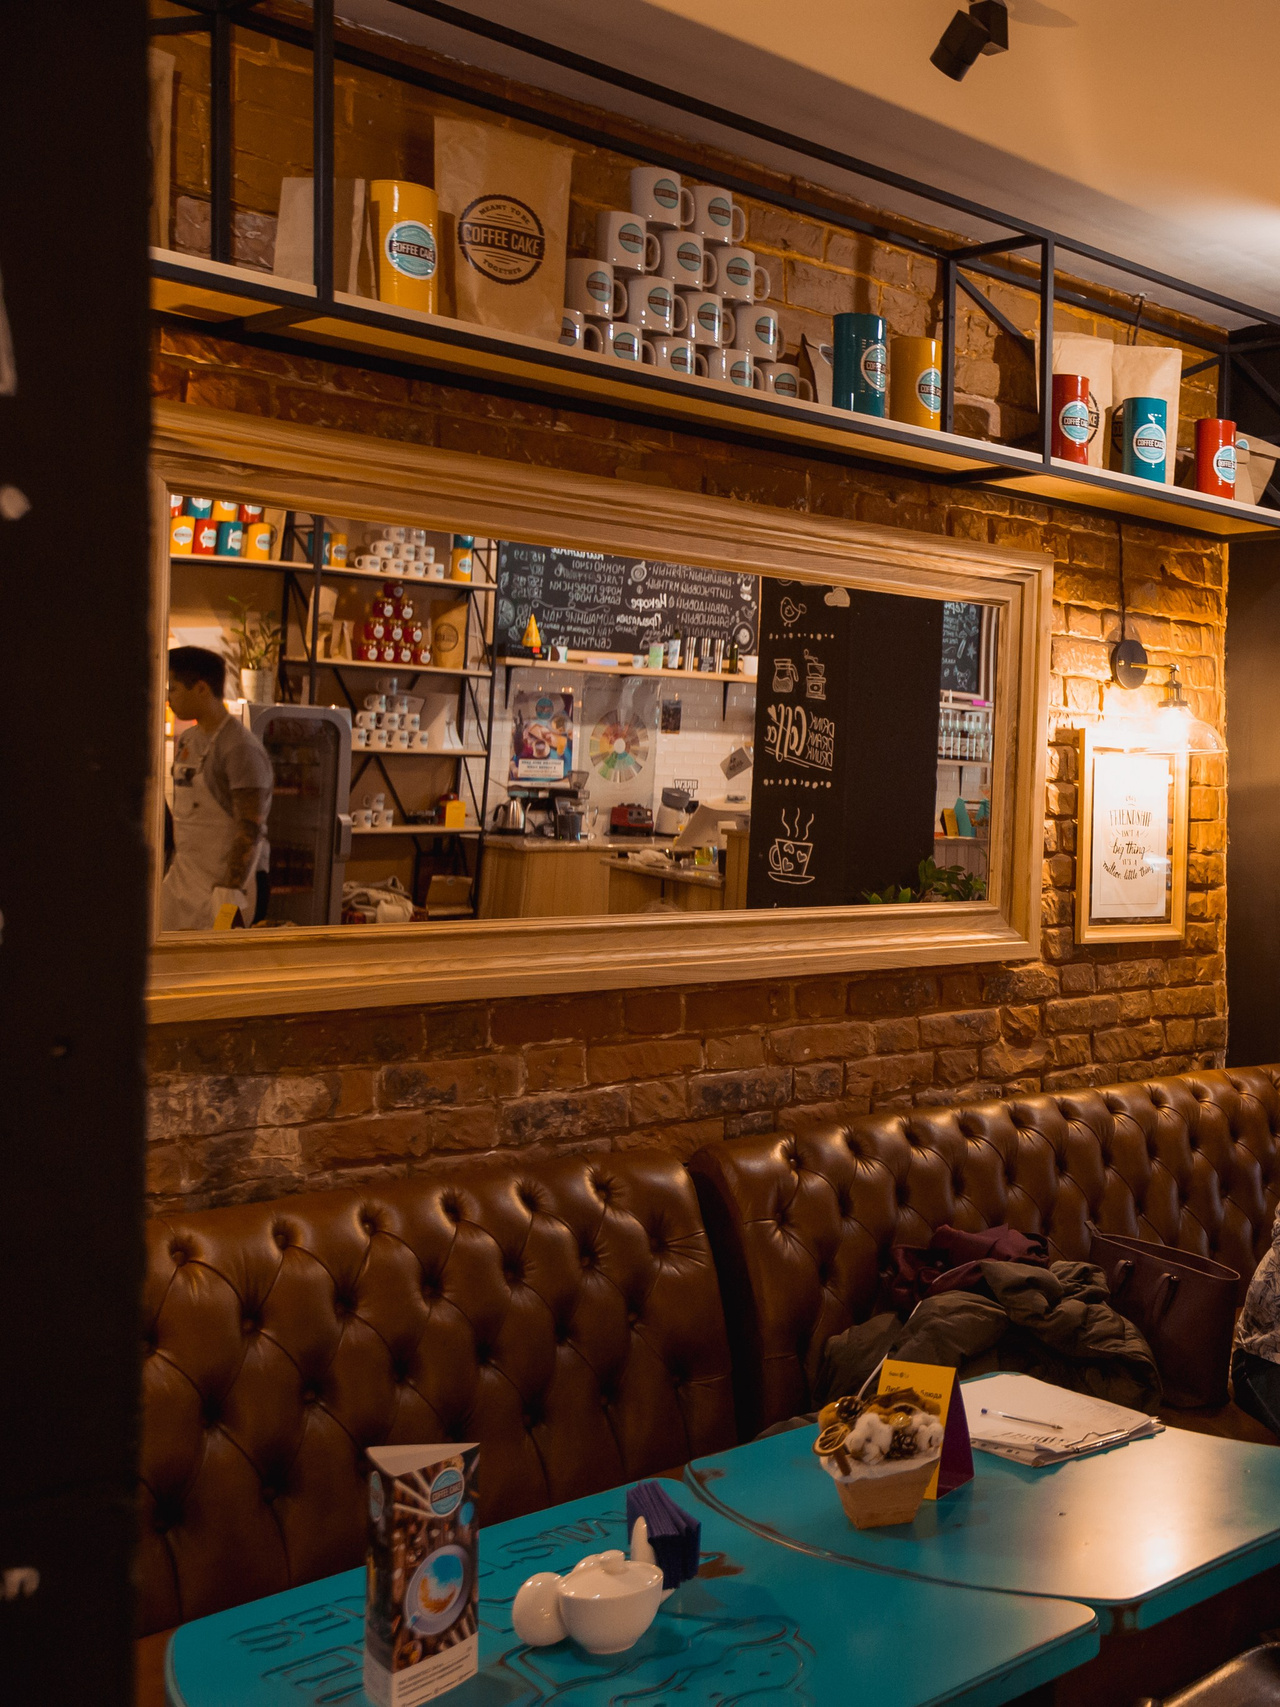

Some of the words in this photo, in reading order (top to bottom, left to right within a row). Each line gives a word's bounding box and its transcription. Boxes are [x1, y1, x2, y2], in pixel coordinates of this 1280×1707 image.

[478, 204, 508, 216] MEANT
[510, 207, 521, 217] TO
[519, 212, 531, 225] BE
[463, 224, 508, 248] COFFEE
[510, 234, 542, 257] CAKE
[482, 259, 523, 275] TOGETHER
[1109, 809, 1152, 827] FRIENDSHIP
[1112, 837, 1125, 860] big
[1125, 841, 1146, 860] thing
[1124, 868, 1138, 880] little
[432, 1489, 449, 1501] COFFEE
